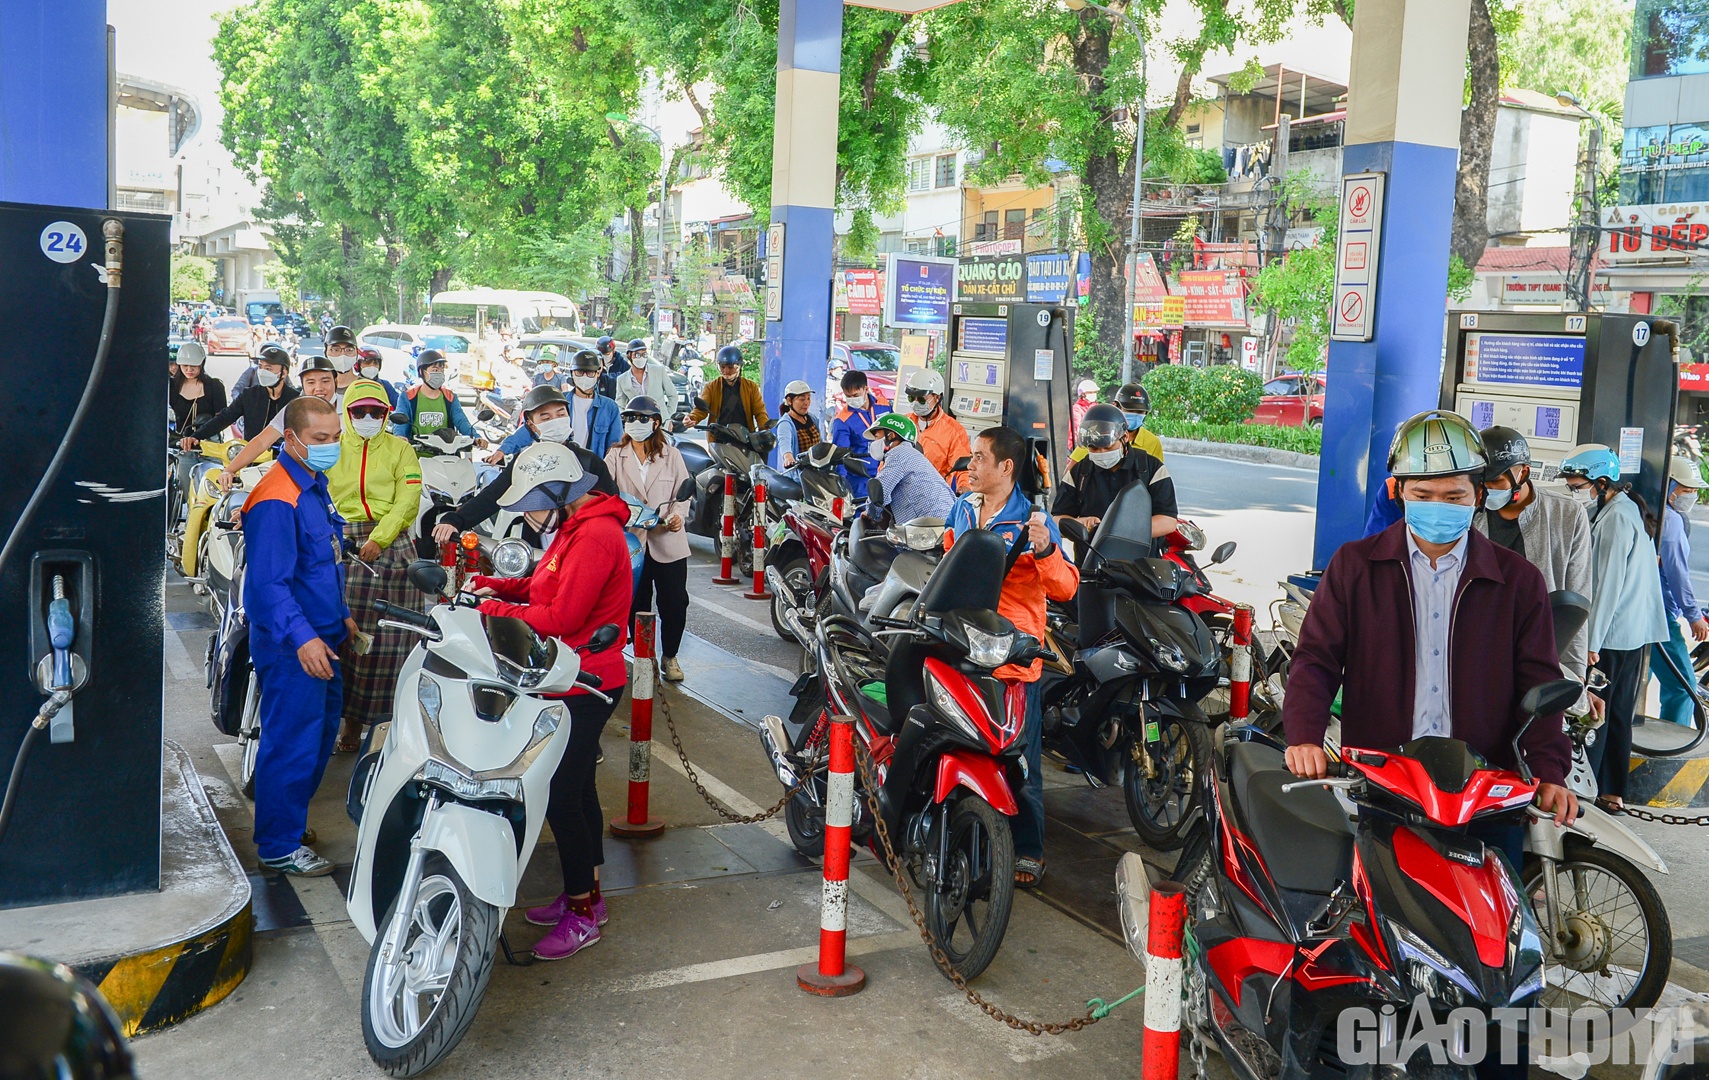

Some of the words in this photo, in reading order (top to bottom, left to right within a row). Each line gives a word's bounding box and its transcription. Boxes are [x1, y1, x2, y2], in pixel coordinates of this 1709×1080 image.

[1667, 134, 1703, 155] BẾP
[1658, 205, 1700, 216] CÔNG
[1609, 214, 1643, 252] TỦ
[1651, 212, 1709, 252] BẾP
[47, 232, 82, 253] 24
[976, 242, 1016, 253] PHOTOCOPY
[958, 256, 996, 282] QUẢNG
[1029, 258, 1040, 276] ĐÀO
[1041, 261, 1051, 279] TẠO
[1052, 257, 1062, 276] LÁI
[848, 280, 865, 298] CẦM
[926, 286, 934, 295] SỰ
[934, 286, 946, 295] KIỆN
[1002, 280, 1016, 294] CHỮ
[1190, 283, 1205, 296] KÍNH
[1208, 282, 1218, 295] SẮT
[1506, 282, 1526, 291] TRƯỜNG
[1542, 284, 1561, 292] QUANG
[1040, 314, 1049, 322] 19
[1463, 316, 1475, 326] 18
[1569, 317, 1582, 329] 17
[1636, 328, 1648, 340] 17
[1680, 372, 1700, 380] Whoo
[887, 418, 905, 430] Grab
[482, 688, 506, 696] HONDA
[909, 717, 925, 728] HONDA
[1448, 851, 1481, 864] HONDA
